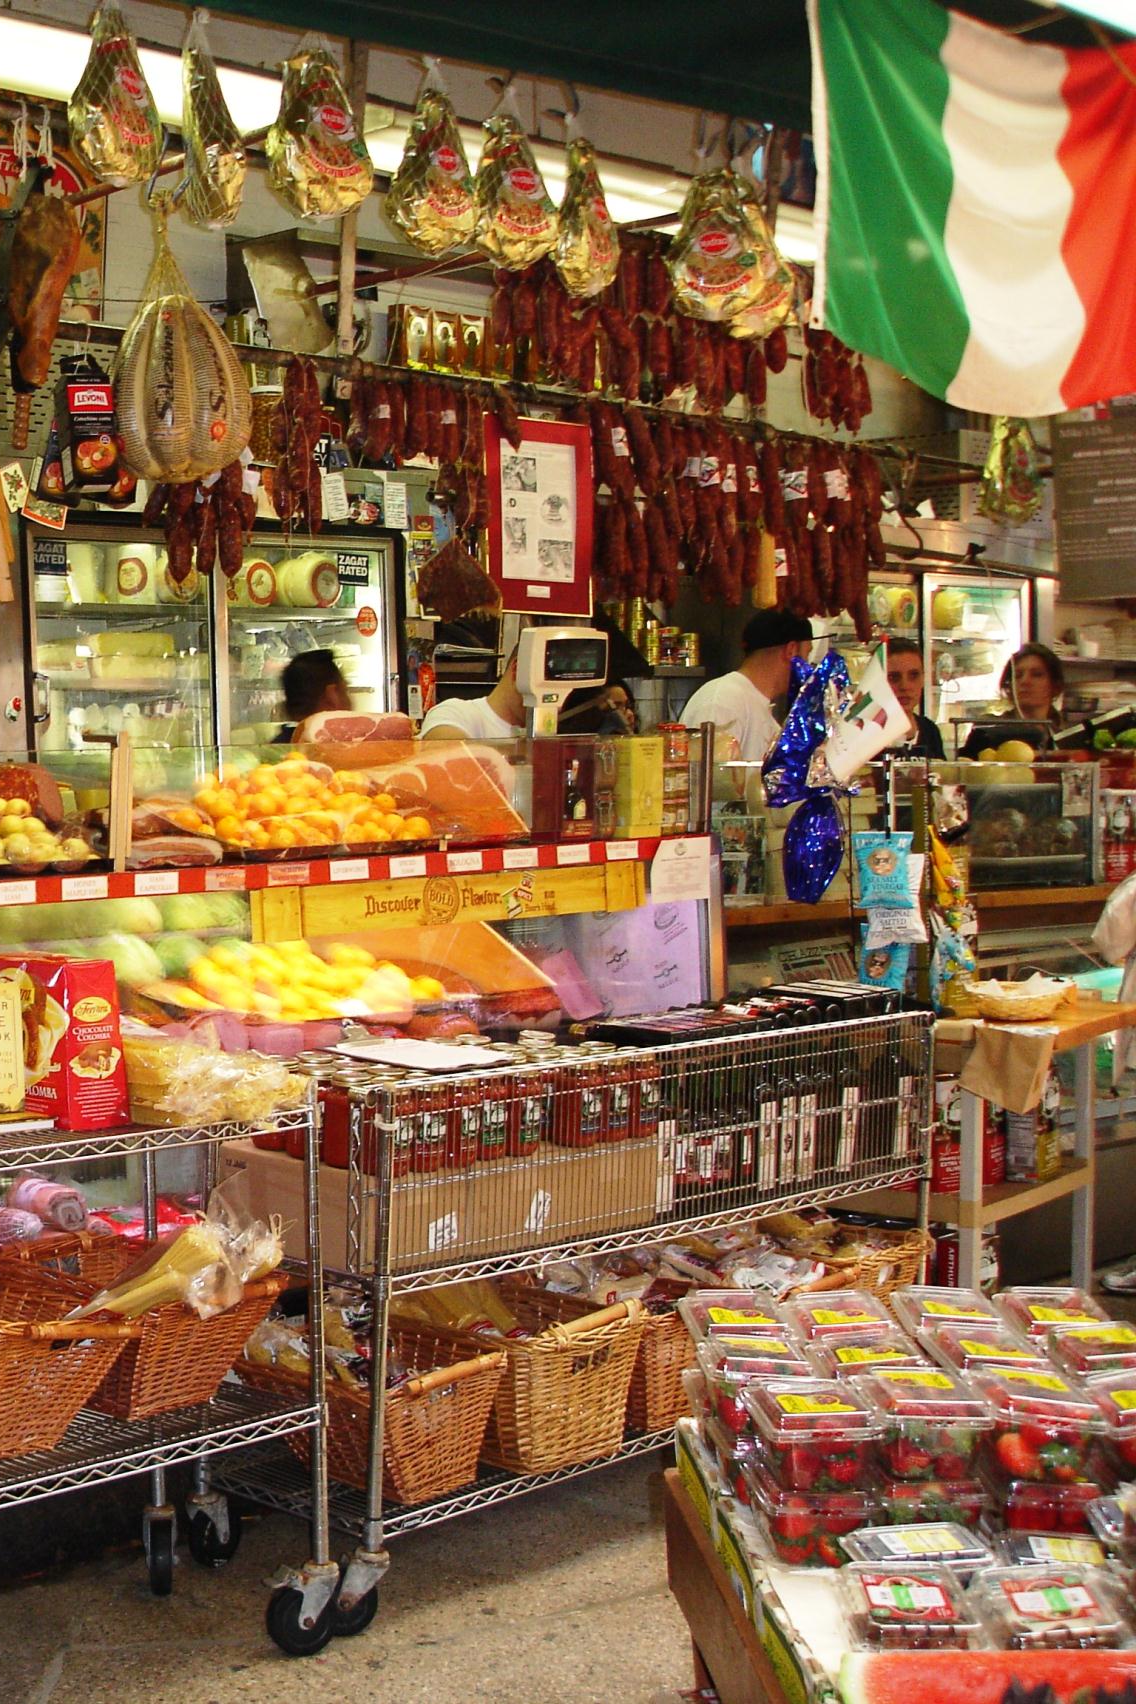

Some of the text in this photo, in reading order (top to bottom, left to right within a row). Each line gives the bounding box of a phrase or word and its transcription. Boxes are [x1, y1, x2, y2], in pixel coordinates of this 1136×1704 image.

[76, 393, 106, 403] LEVONI
[338, 554, 368, 567] ZAGAT
[338, 565, 368, 577] RATED
[871, 883, 905, 891] VINEGAR
[428, 889, 454, 908] BOLD
[364, 894, 422, 918] Discover
[875, 909, 910, 918] ORIGINAL
[879, 918, 907, 926] SALTED
[72, 1024, 113, 1036] CHOCOLATE
[76, 1032, 111, 1042] COLOMBA
[25, 1085, 58, 1099] OLOMBA
